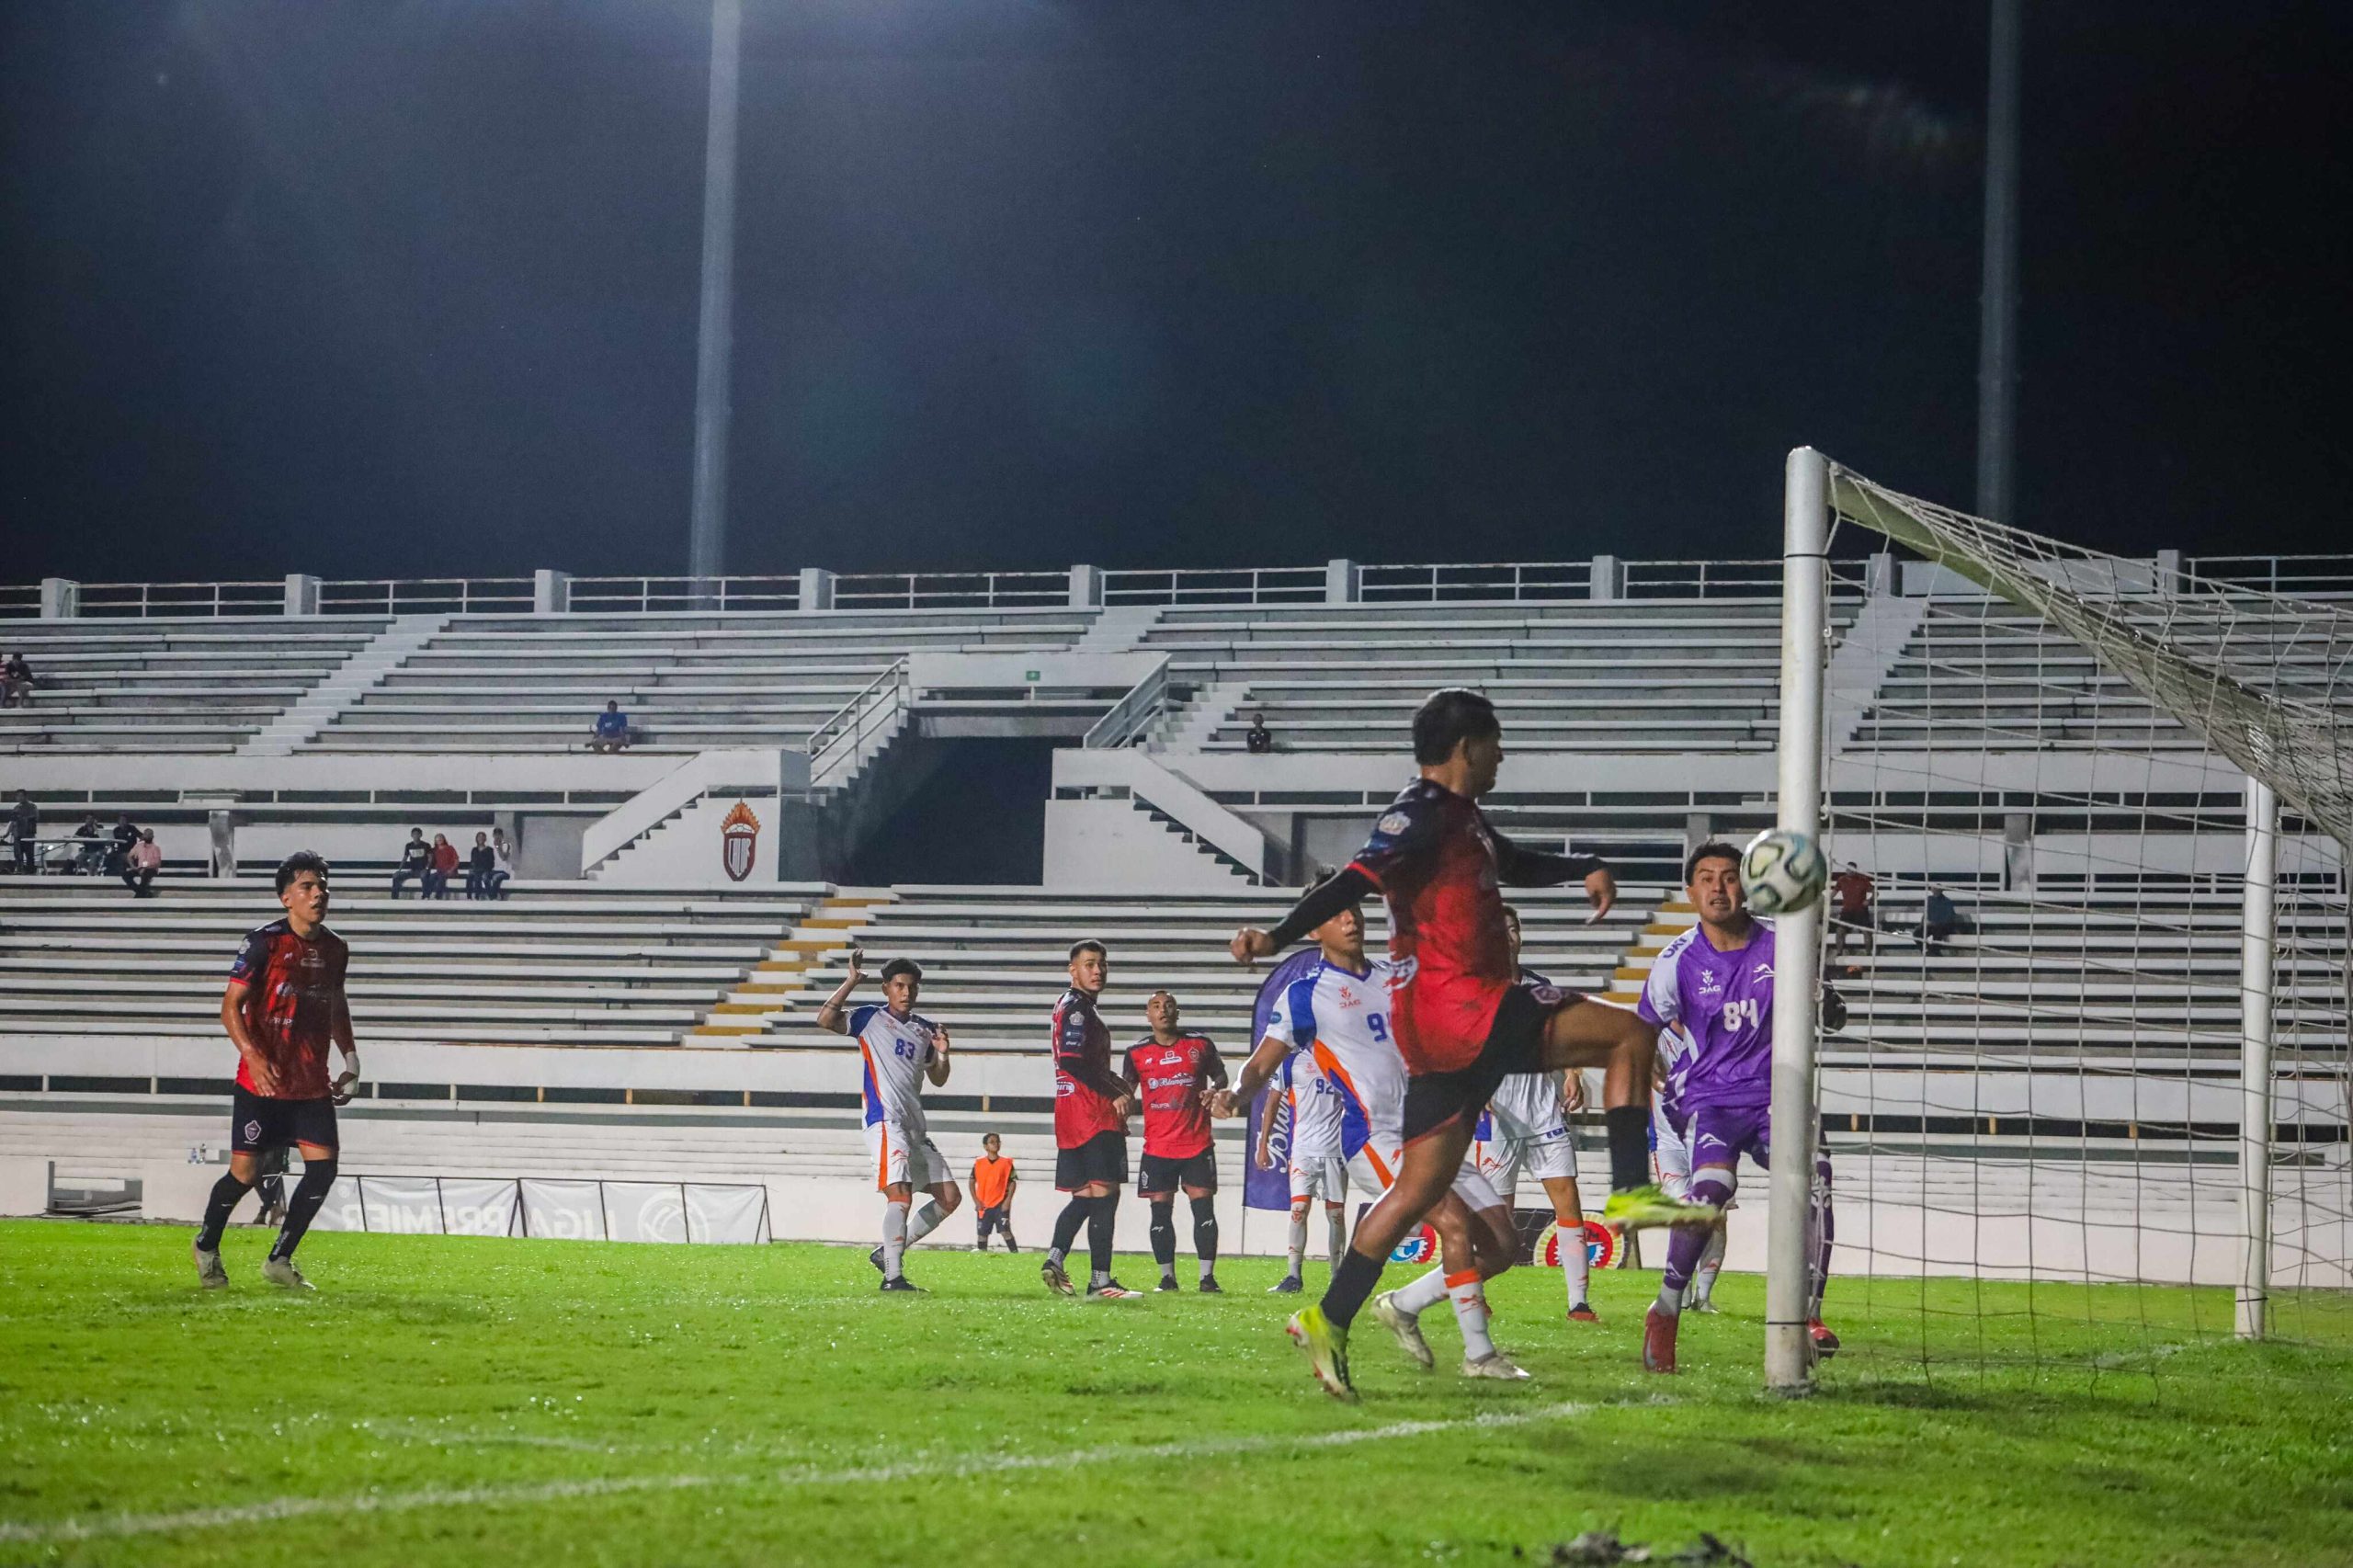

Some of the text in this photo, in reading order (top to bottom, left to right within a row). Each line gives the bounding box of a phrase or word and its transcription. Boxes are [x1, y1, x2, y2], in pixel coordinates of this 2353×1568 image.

[1367, 1012, 1392, 1042] 9
[1723, 998, 1759, 1032] 84
[894, 1038, 915, 1061] 83
